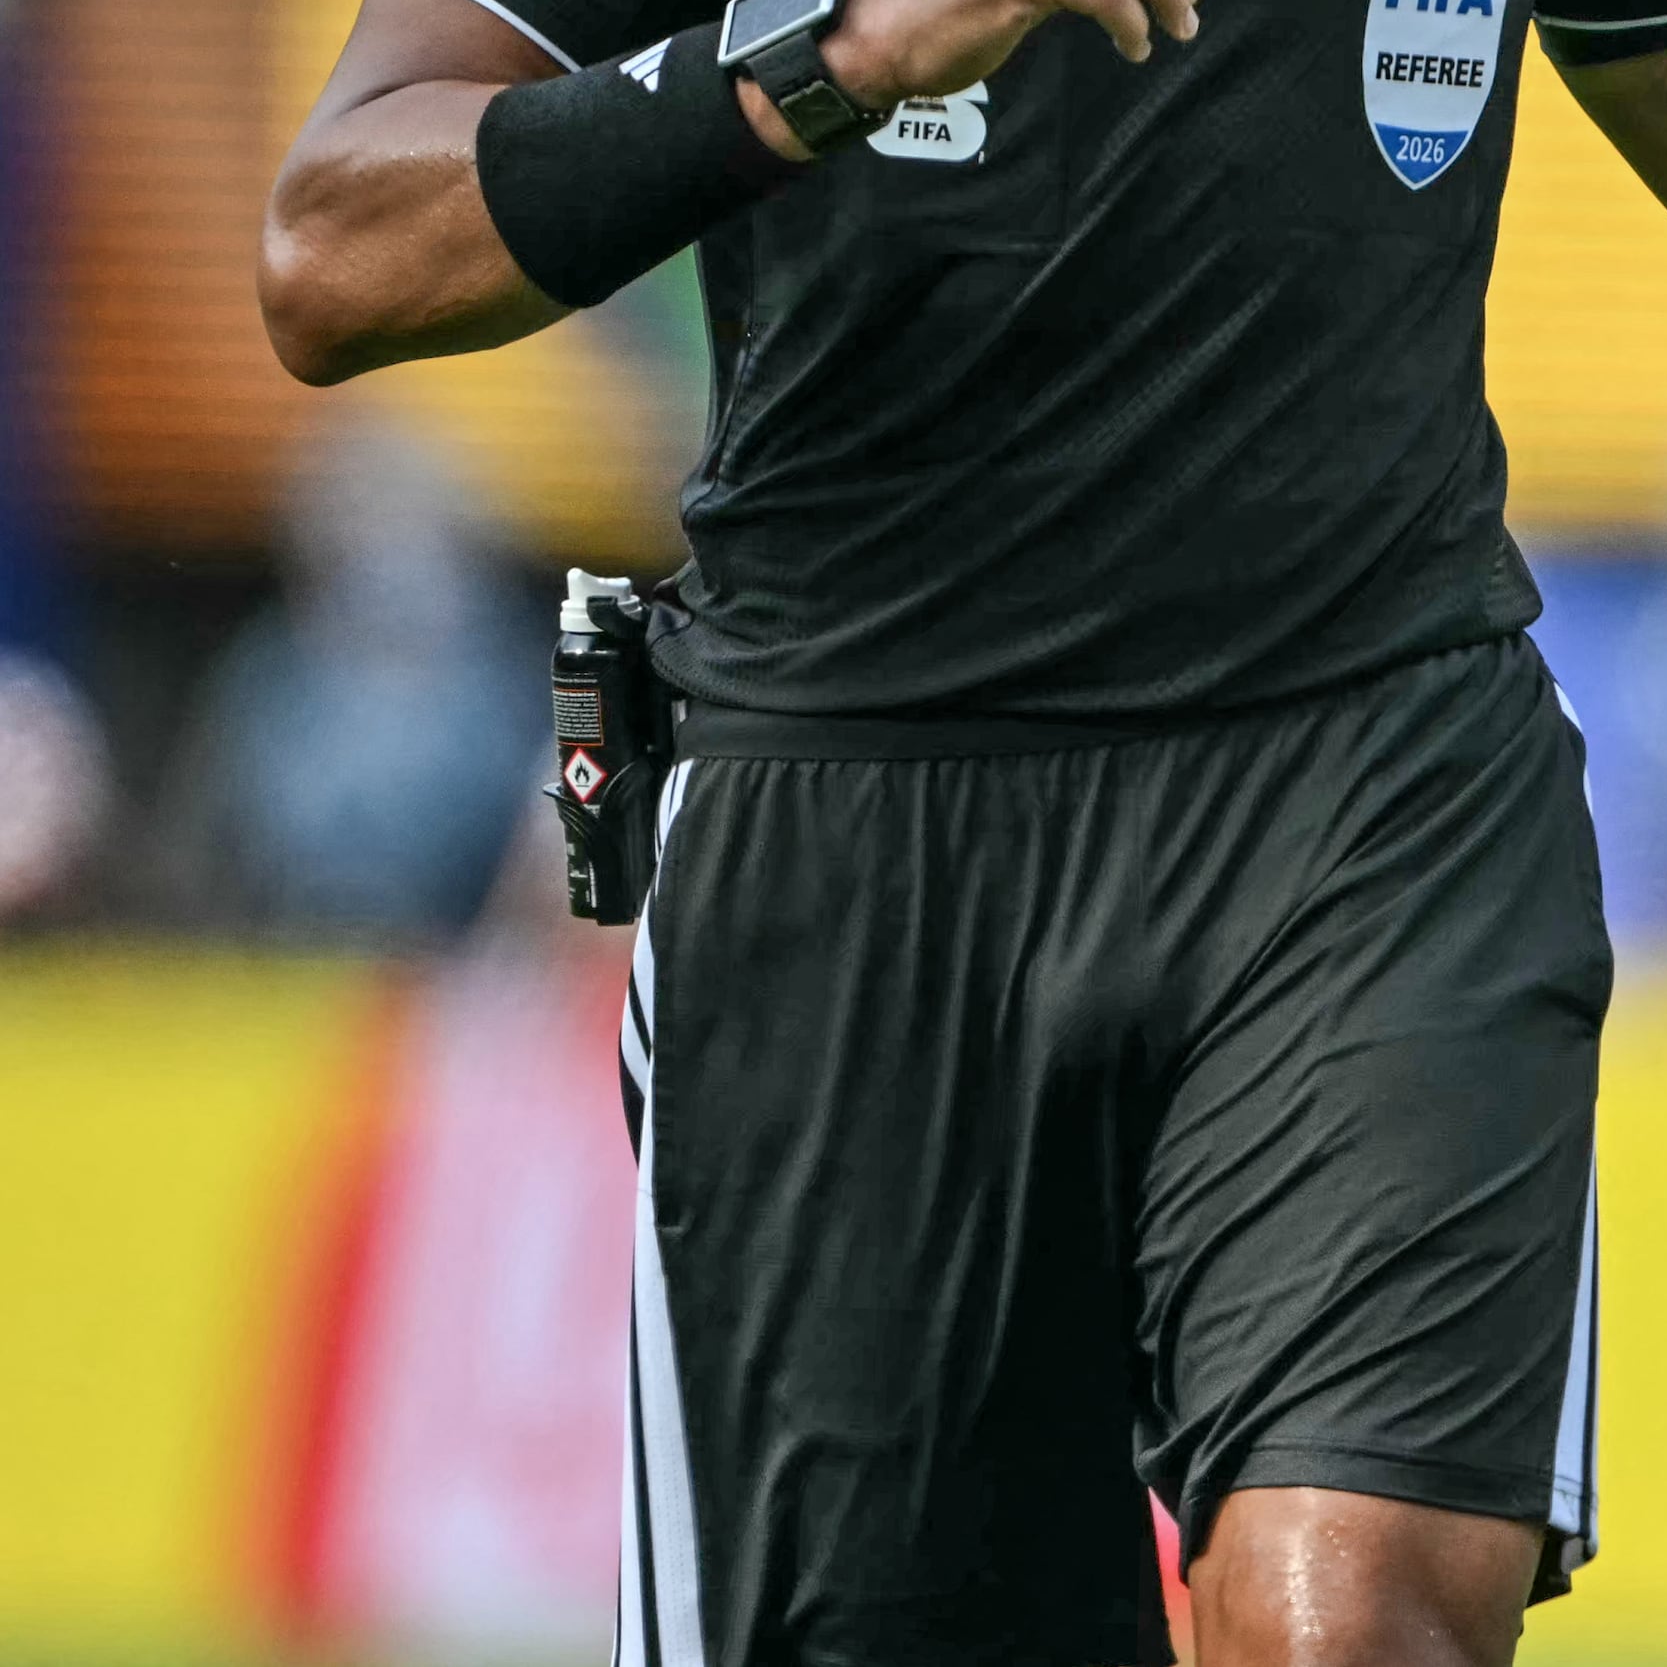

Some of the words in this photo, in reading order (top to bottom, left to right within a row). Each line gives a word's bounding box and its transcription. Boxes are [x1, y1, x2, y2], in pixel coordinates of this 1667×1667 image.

[1375, 51, 1485, 88] REFEREE
[898, 119, 952, 142] FIFA
[1396, 135, 1446, 164] 2026
